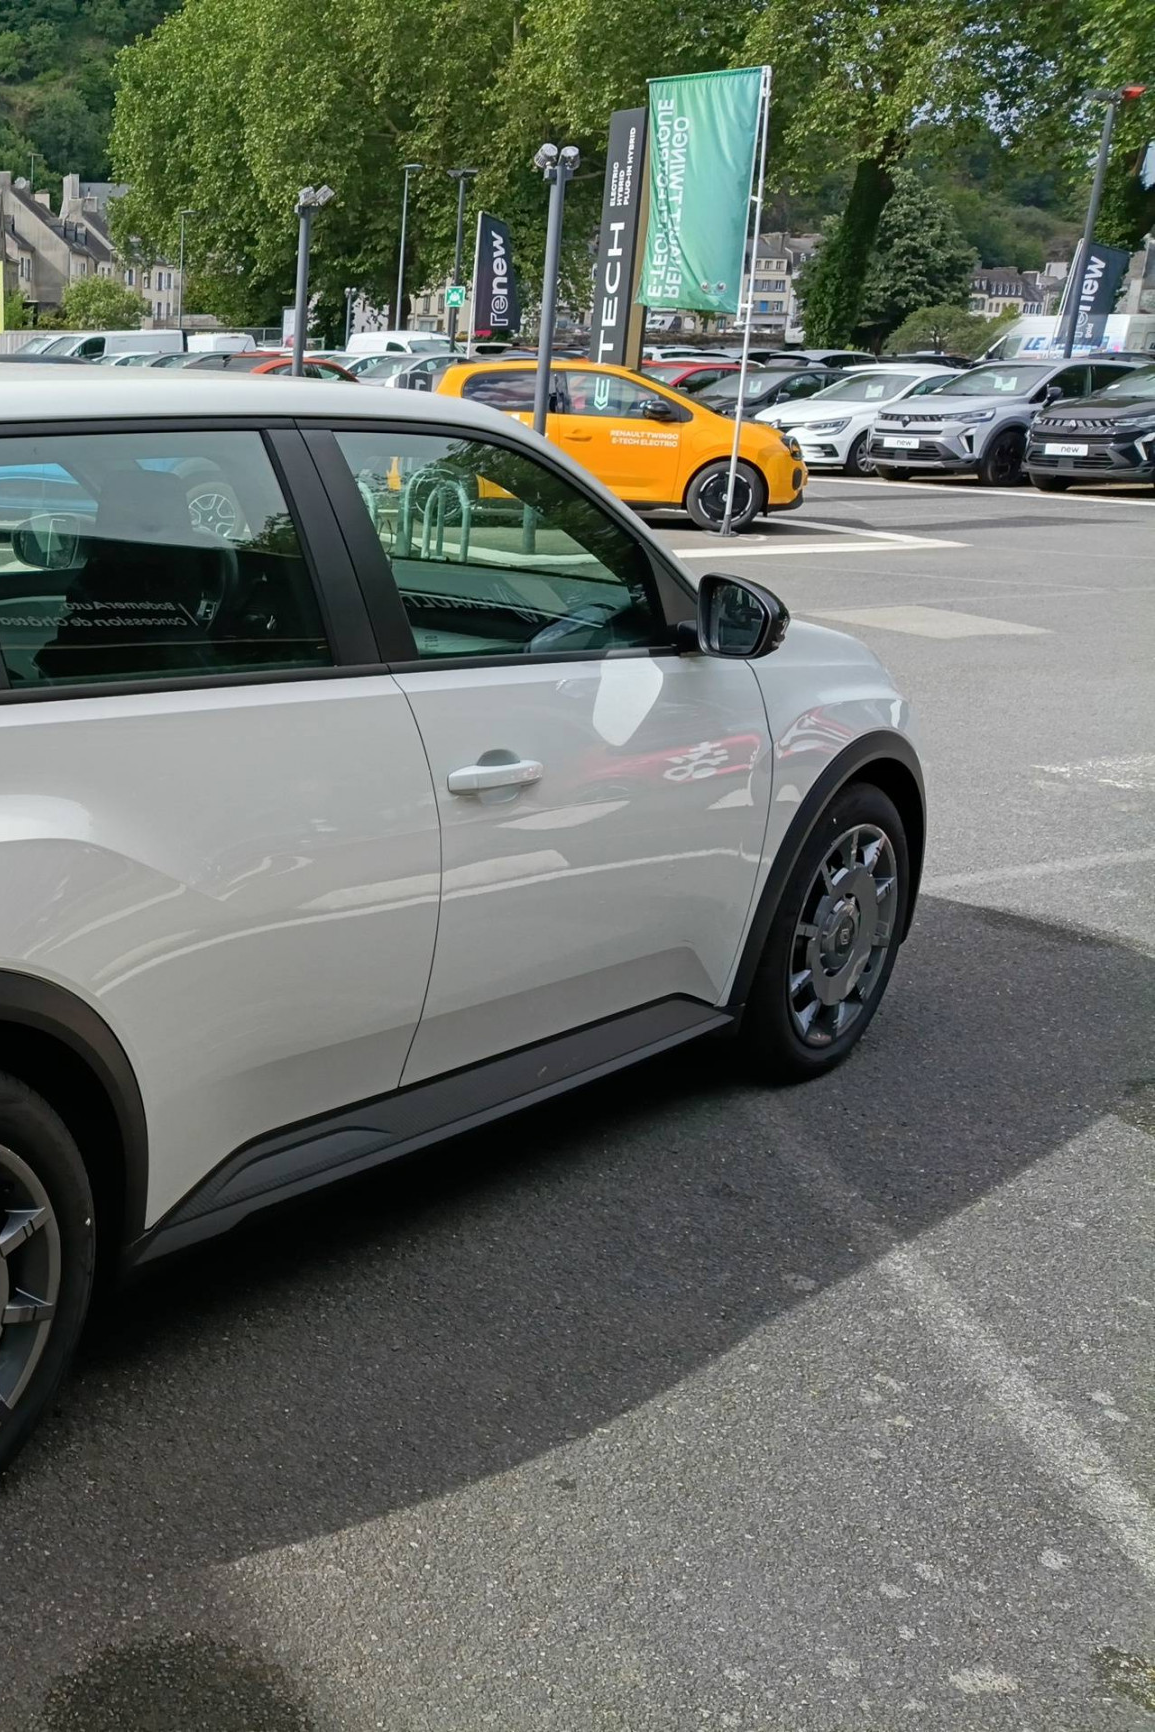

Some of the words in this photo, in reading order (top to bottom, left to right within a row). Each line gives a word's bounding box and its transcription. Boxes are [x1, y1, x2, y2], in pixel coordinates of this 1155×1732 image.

[627, 127, 636, 164] HYBRID
[617, 170, 625, 206] HYBRID
[490, 230, 509, 326] renew
[1085, 323, 1094, 339] gold
[610, 430, 646, 439] RENAULT
[647, 432, 679, 440] TWINGO
[612, 438, 639, 446] E-TECH
